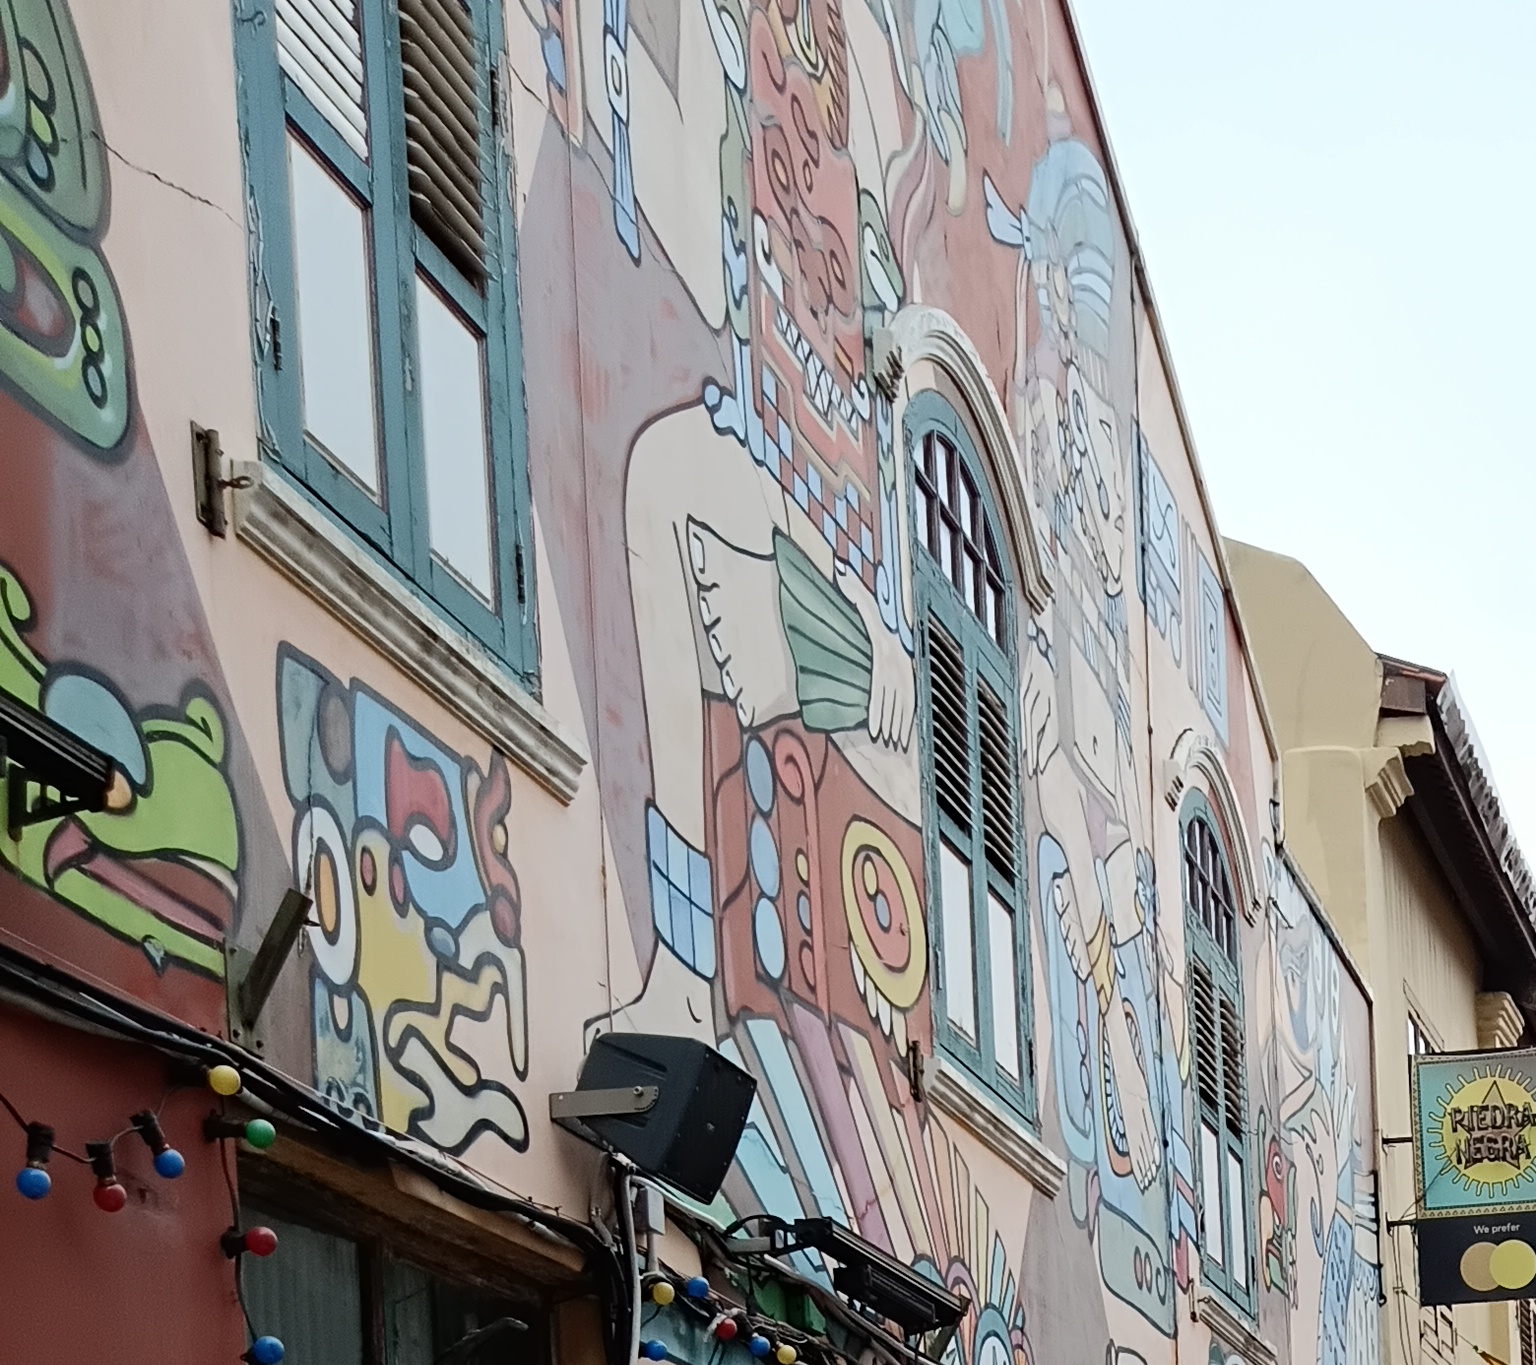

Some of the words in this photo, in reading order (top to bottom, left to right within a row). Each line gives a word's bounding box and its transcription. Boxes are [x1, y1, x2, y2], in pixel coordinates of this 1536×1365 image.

[1455, 1133, 1532, 1165] NEGRA
[1473, 1225, 1490, 1235] We
[1491, 1222, 1521, 1235] prefer
